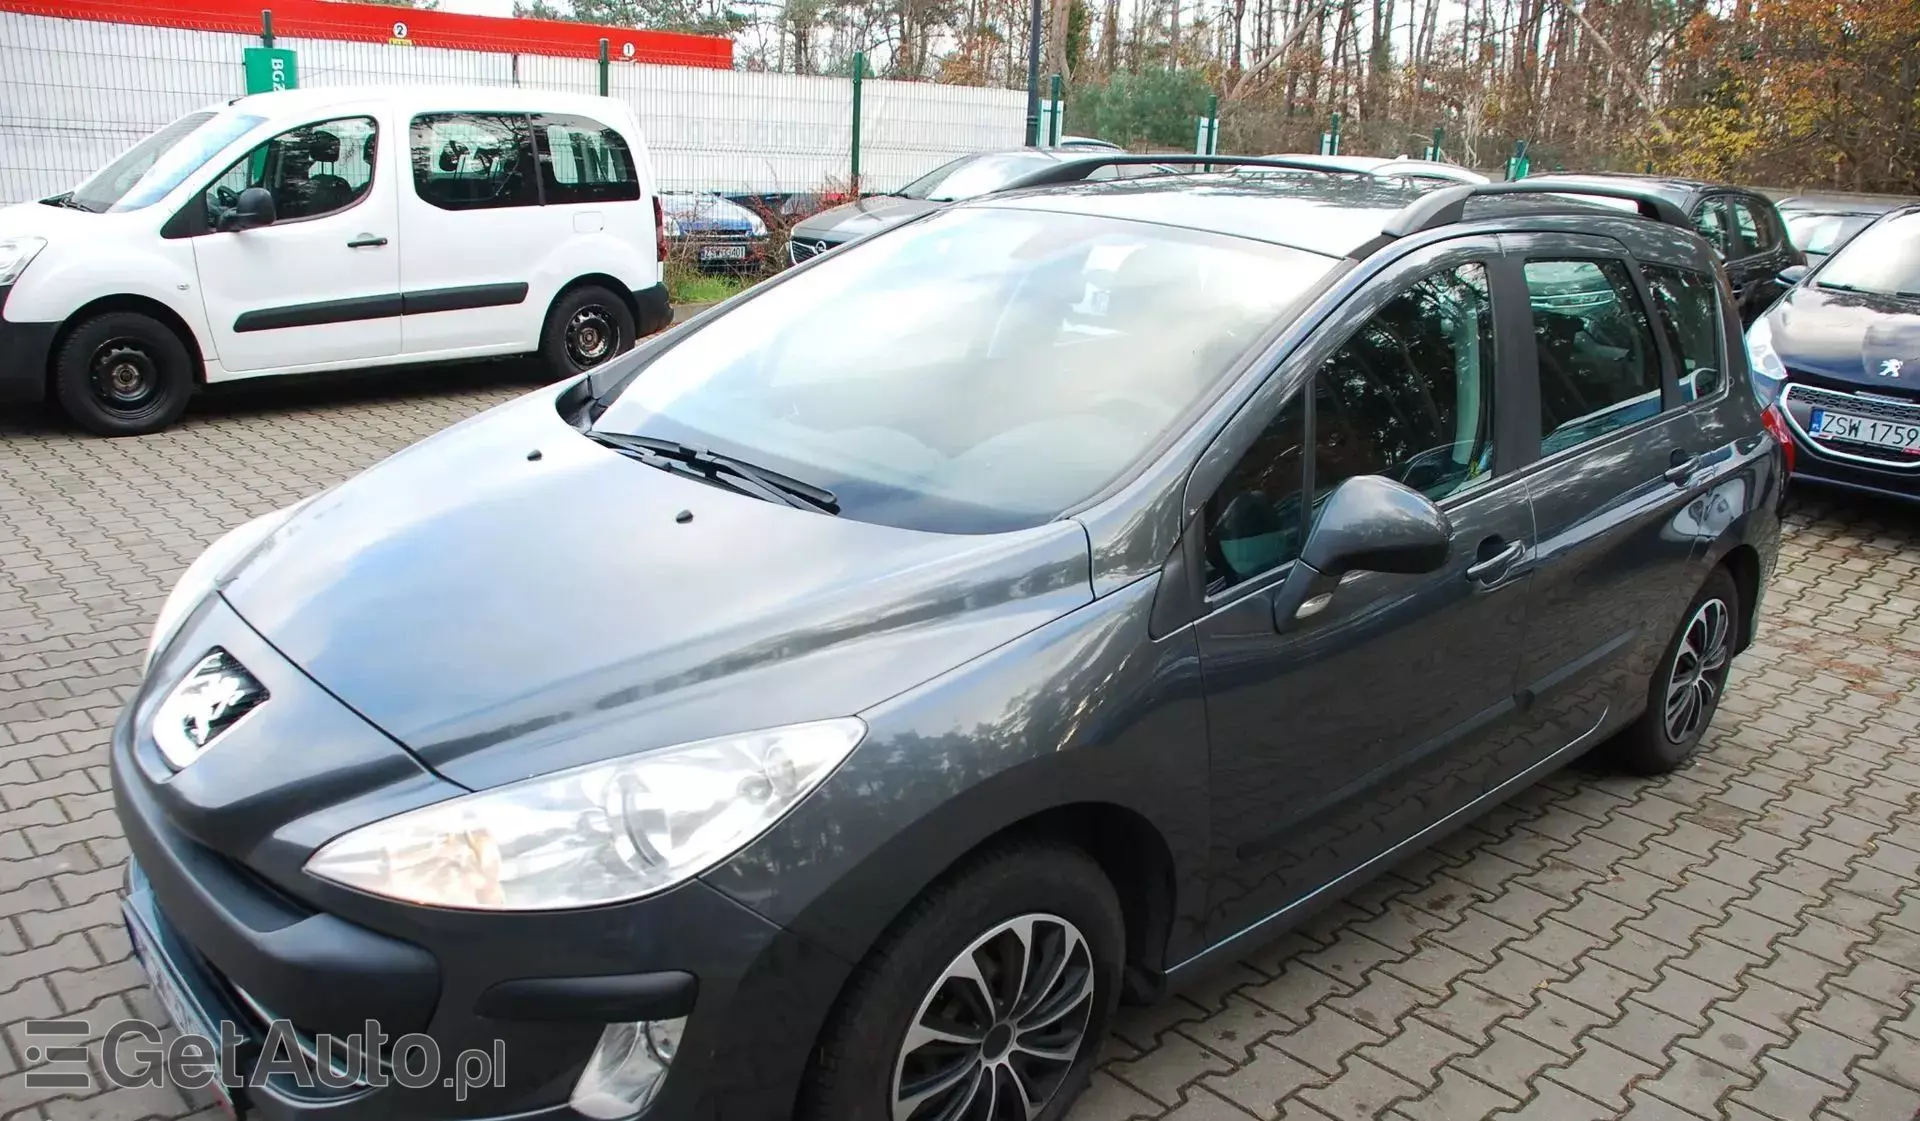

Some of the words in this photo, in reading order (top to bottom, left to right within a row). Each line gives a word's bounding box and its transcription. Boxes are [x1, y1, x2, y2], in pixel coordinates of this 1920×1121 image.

[396, 24, 404, 36] 2
[1821, 413, 1862, 438] ZSW
[1870, 422, 1920, 448] 1759
